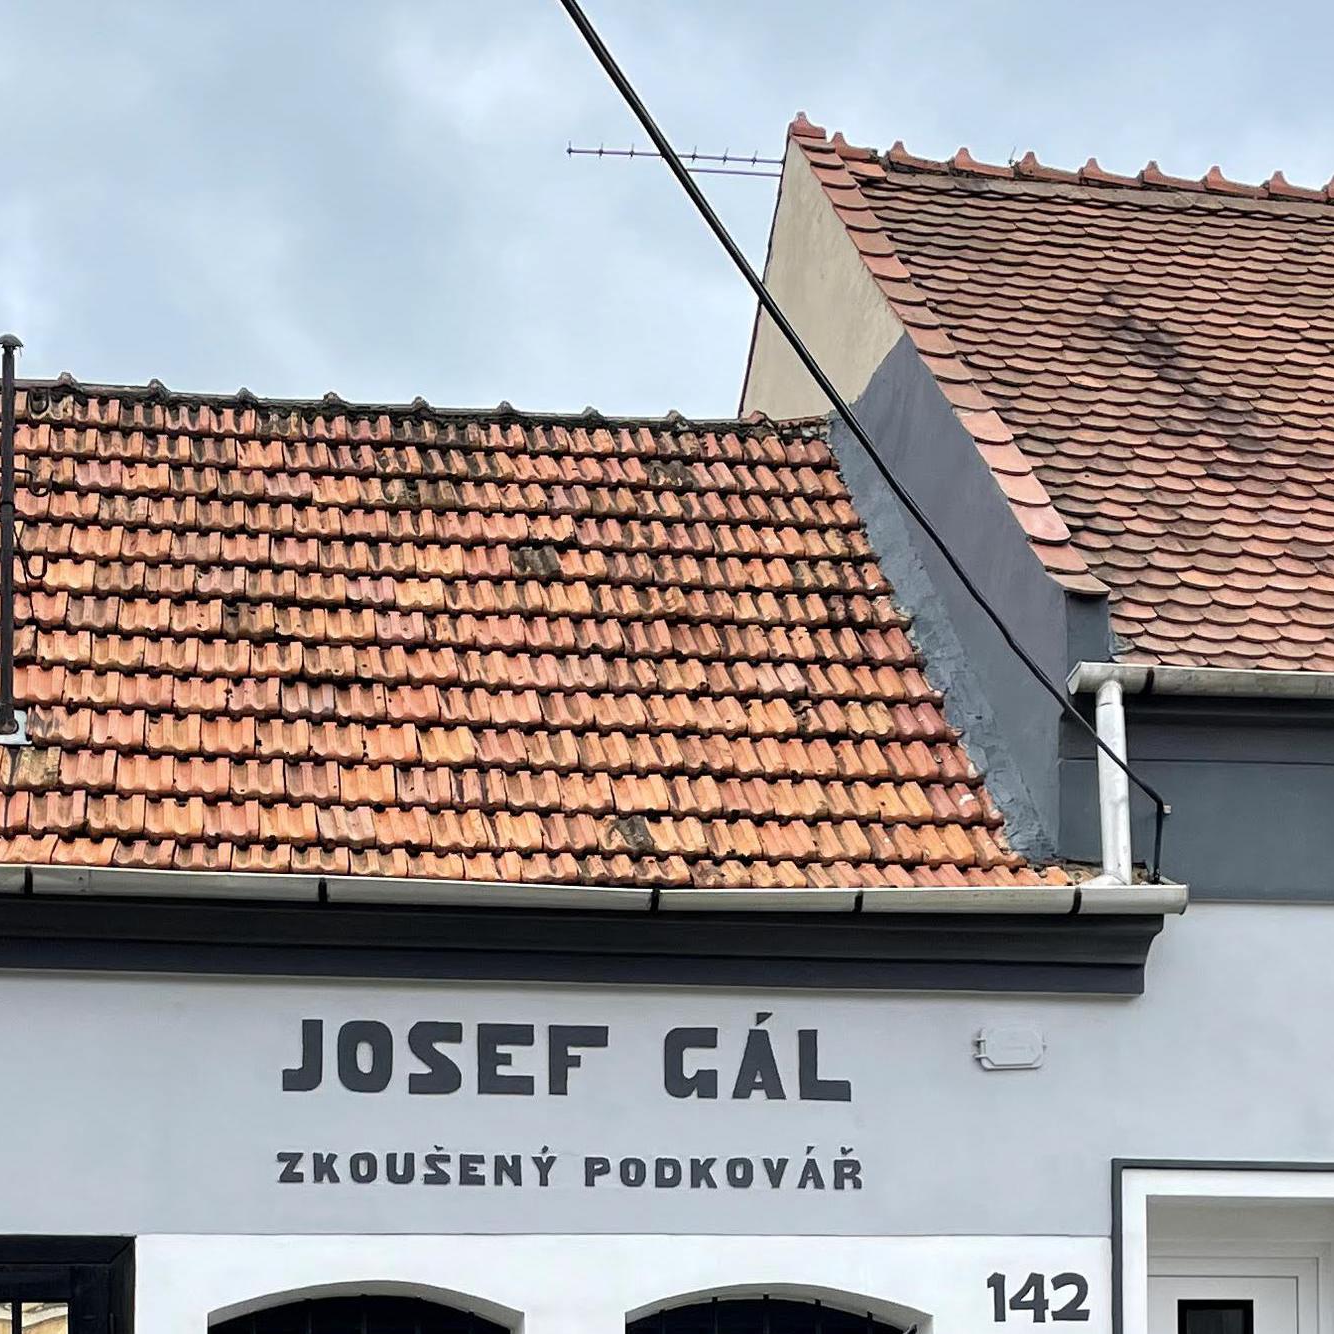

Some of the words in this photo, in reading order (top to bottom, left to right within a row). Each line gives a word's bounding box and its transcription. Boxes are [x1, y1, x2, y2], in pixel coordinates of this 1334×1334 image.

[282, 1019, 610, 1097] JOSEF
[663, 1012, 852, 1102] GÁL
[276, 1145, 558, 1187] ZKOUŠENÝ
[584, 1146, 863, 1190] PODKOVÁŘ
[986, 1271, 1091, 1324] 142
